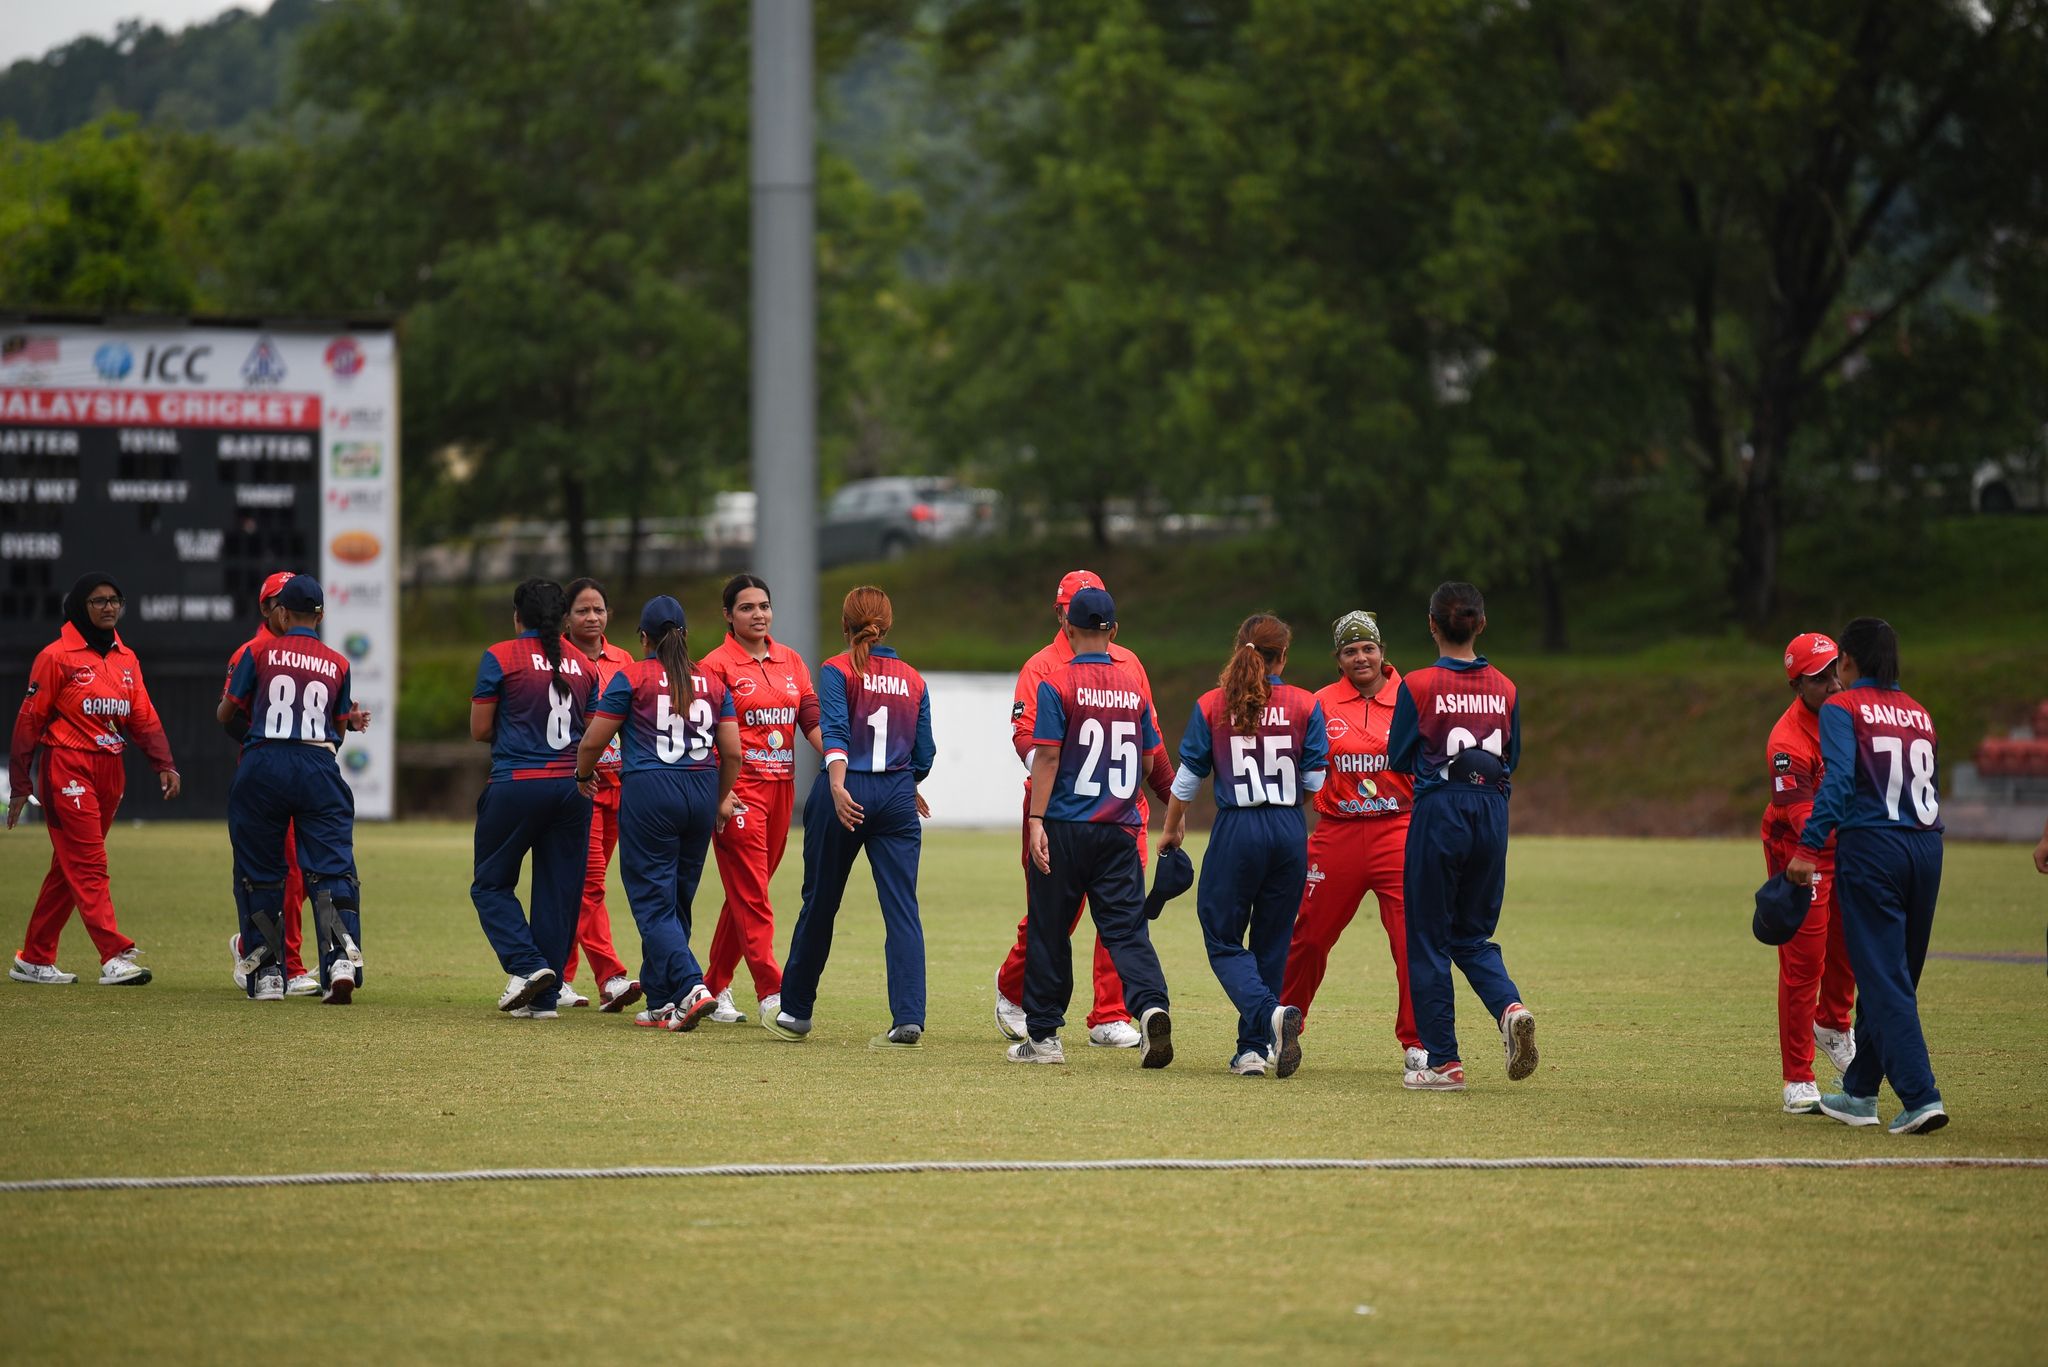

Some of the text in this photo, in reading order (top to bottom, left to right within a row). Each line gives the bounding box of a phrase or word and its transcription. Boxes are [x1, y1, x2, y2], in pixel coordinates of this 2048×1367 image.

[143, 345, 213, 384] ICC
[0, 389, 150, 422] ALAYSIA
[158, 393, 307, 426] CRICKET
[0, 430, 79, 454] ATTER
[119, 428, 180, 454] TOTAL
[218, 435, 311, 460] BATTER
[268, 649, 337, 679] K.KUNWAR
[659, 671, 708, 693] JTI
[863, 672, 910, 697] BARMA
[265, 674, 329, 742] 88
[546, 680, 572, 750] 8
[1435, 693, 1506, 716] ASHMINA
[656, 694, 713, 764] 53
[1860, 704, 1933, 734] SANGITA
[867, 705, 888, 773] 1
[744, 749, 793, 762] SAARA
[1074, 717, 1138, 800] 25
[1333, 753, 1392, 773] BAHRAI
[1230, 735, 1297, 807] 55
[1872, 736, 1939, 826] 78
[73, 796, 80, 810] 1
[1338, 796, 1400, 814] SAARA
[736, 815, 745, 829] 9
[1308, 883, 1316, 898] 7
